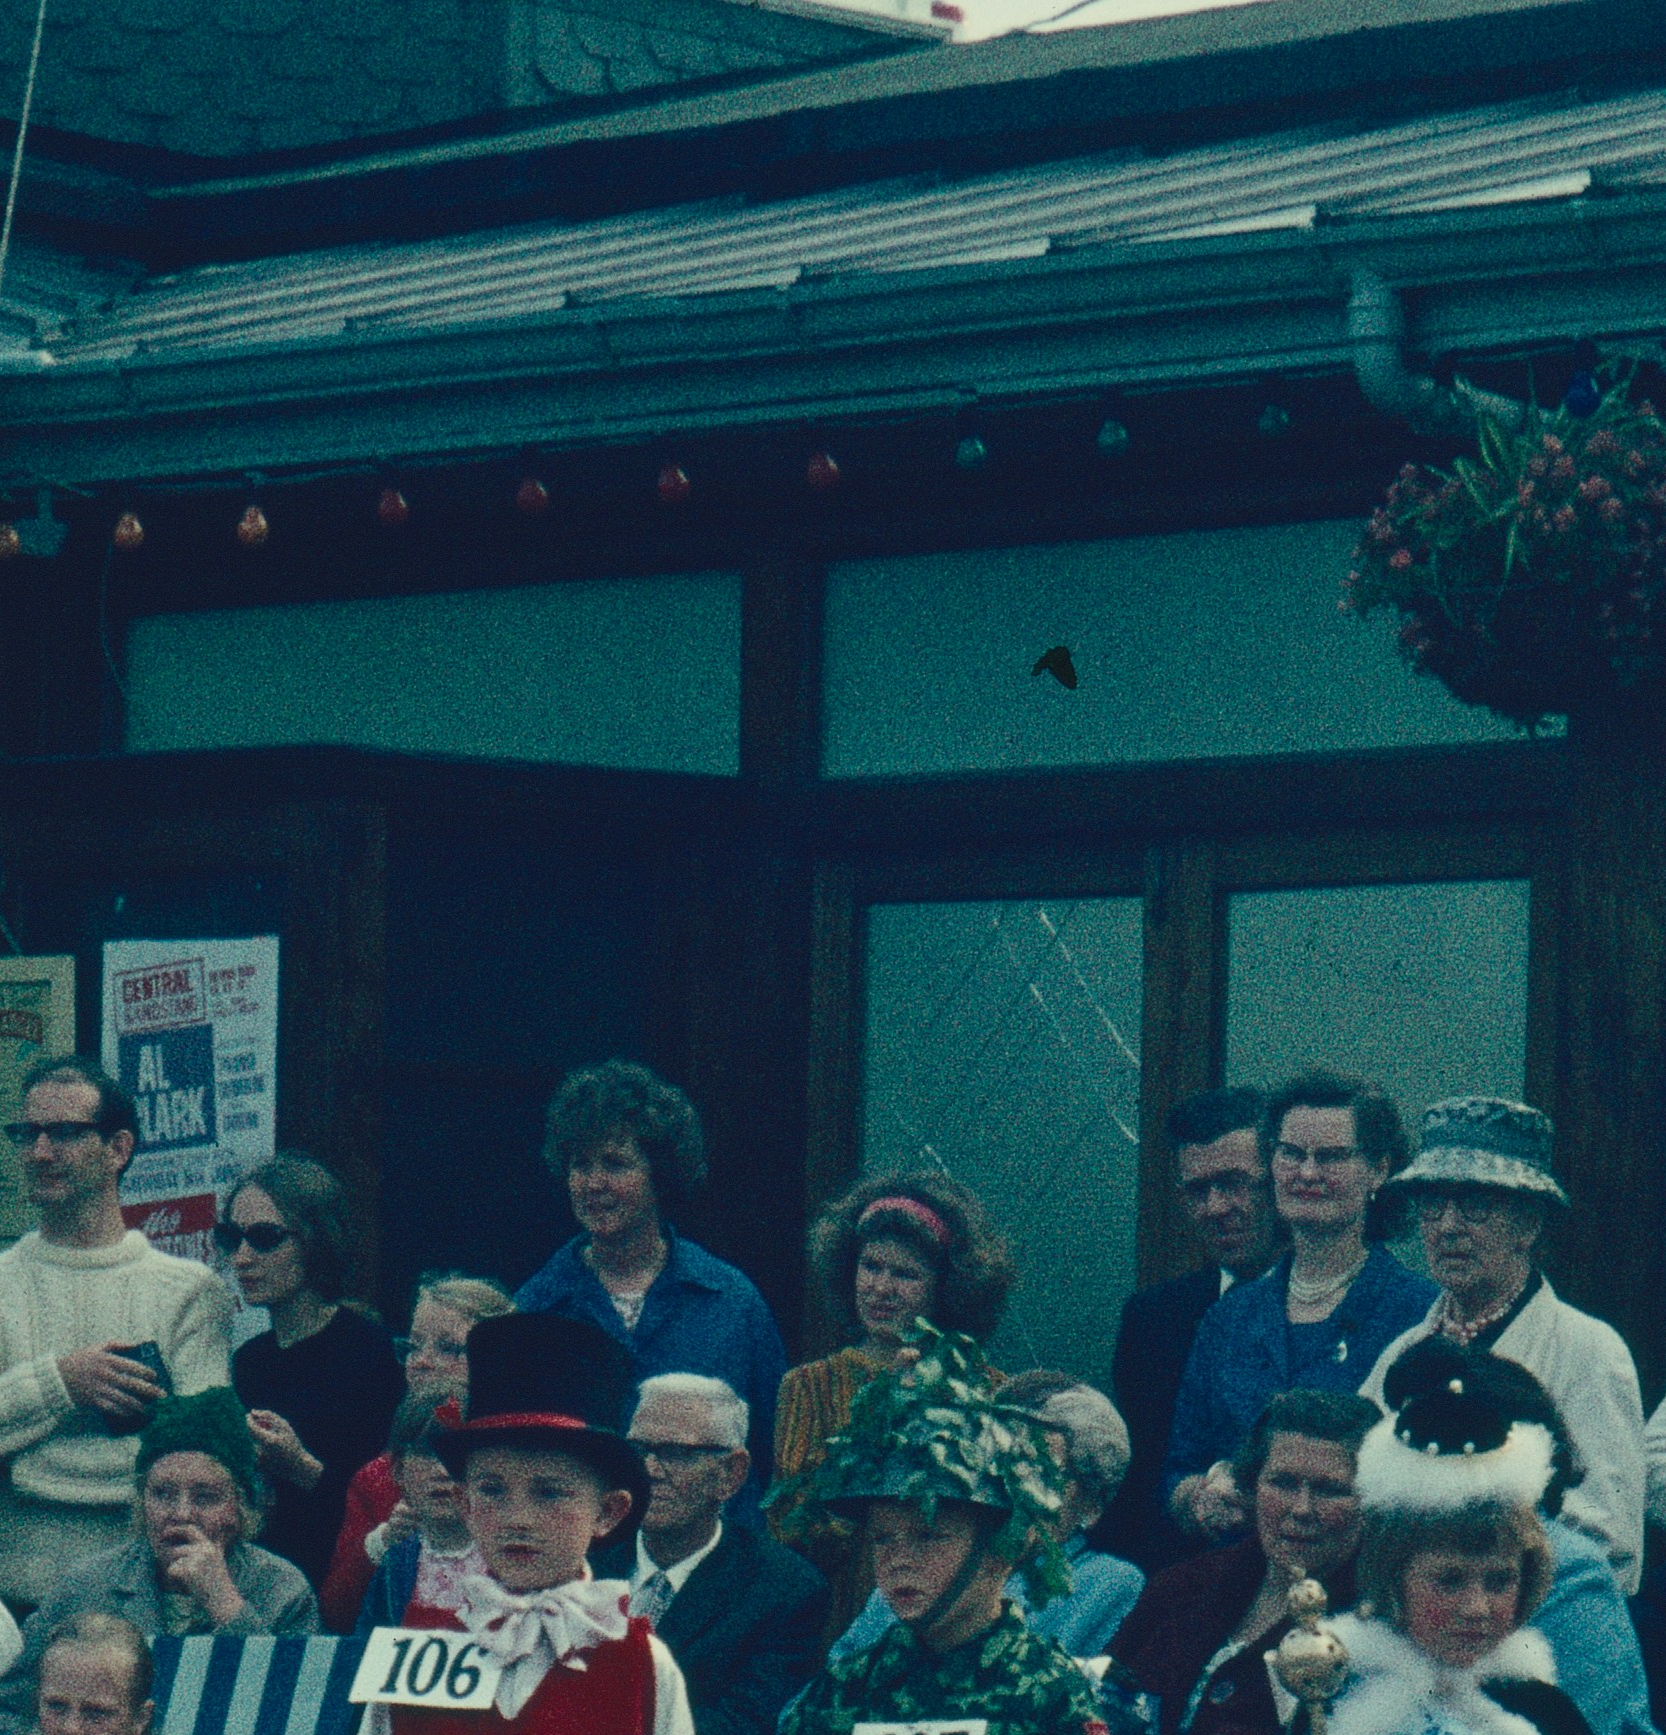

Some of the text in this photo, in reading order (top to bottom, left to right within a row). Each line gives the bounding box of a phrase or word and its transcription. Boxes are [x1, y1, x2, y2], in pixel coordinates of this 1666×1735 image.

[122, 968, 194, 1005] CENTRAL
[138, 1043, 171, 1094] AL
[136, 1086, 206, 1144] LARK
[378, 1636, 487, 1699] 106
